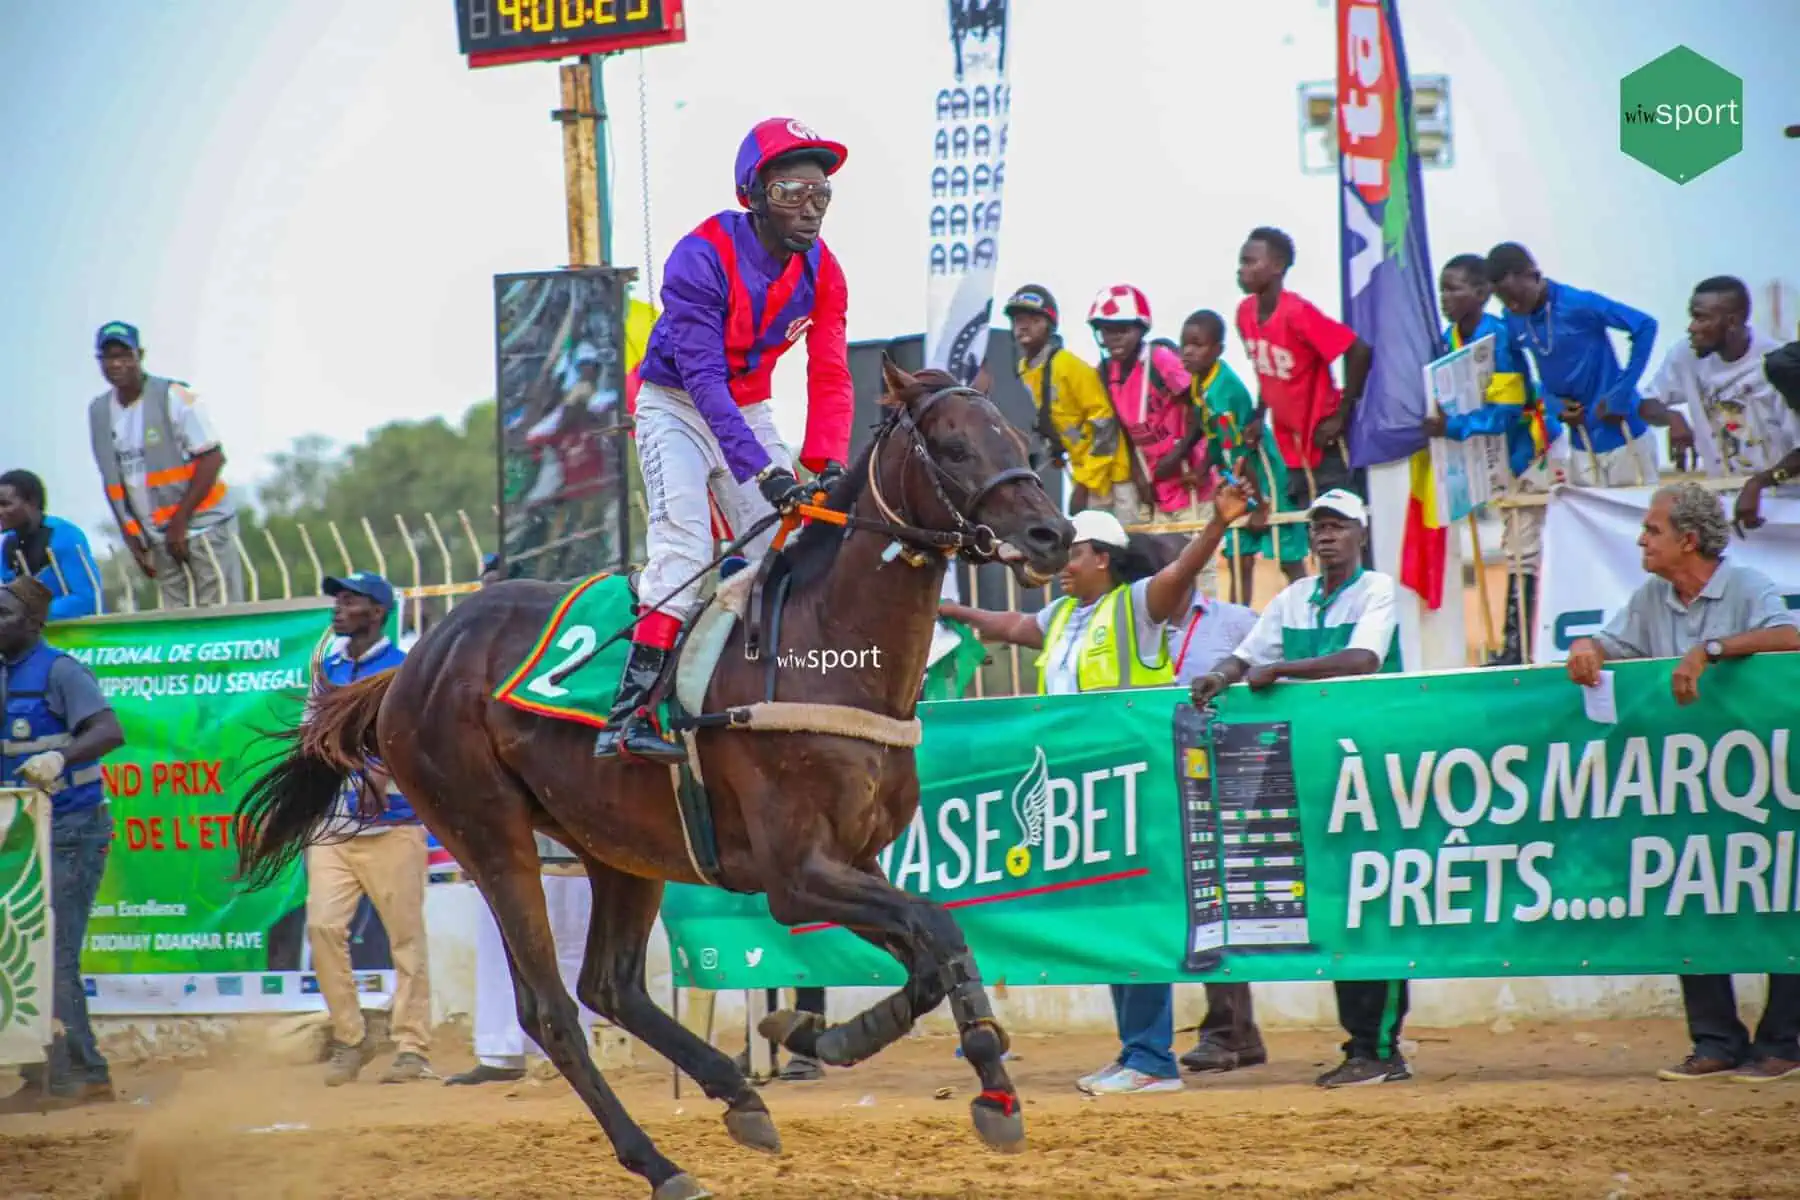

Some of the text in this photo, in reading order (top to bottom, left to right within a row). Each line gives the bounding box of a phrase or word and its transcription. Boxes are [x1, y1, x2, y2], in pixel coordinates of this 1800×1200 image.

[1341, 0, 1385, 298] Vita
[168, 643, 195, 663] DE
[198, 638, 281, 660] GESTION
[528, 625, 596, 697] 2
[98, 668, 308, 701] IPPIQUES DU SENEGAL
[153, 760, 224, 796] PRIX
[1327, 738, 1379, 833] À
[1385, 744, 1529, 829] VOS
[127, 815, 165, 851] DE
[875, 761, 1148, 893] ASE BET
[226, 931, 263, 949] FAYE
